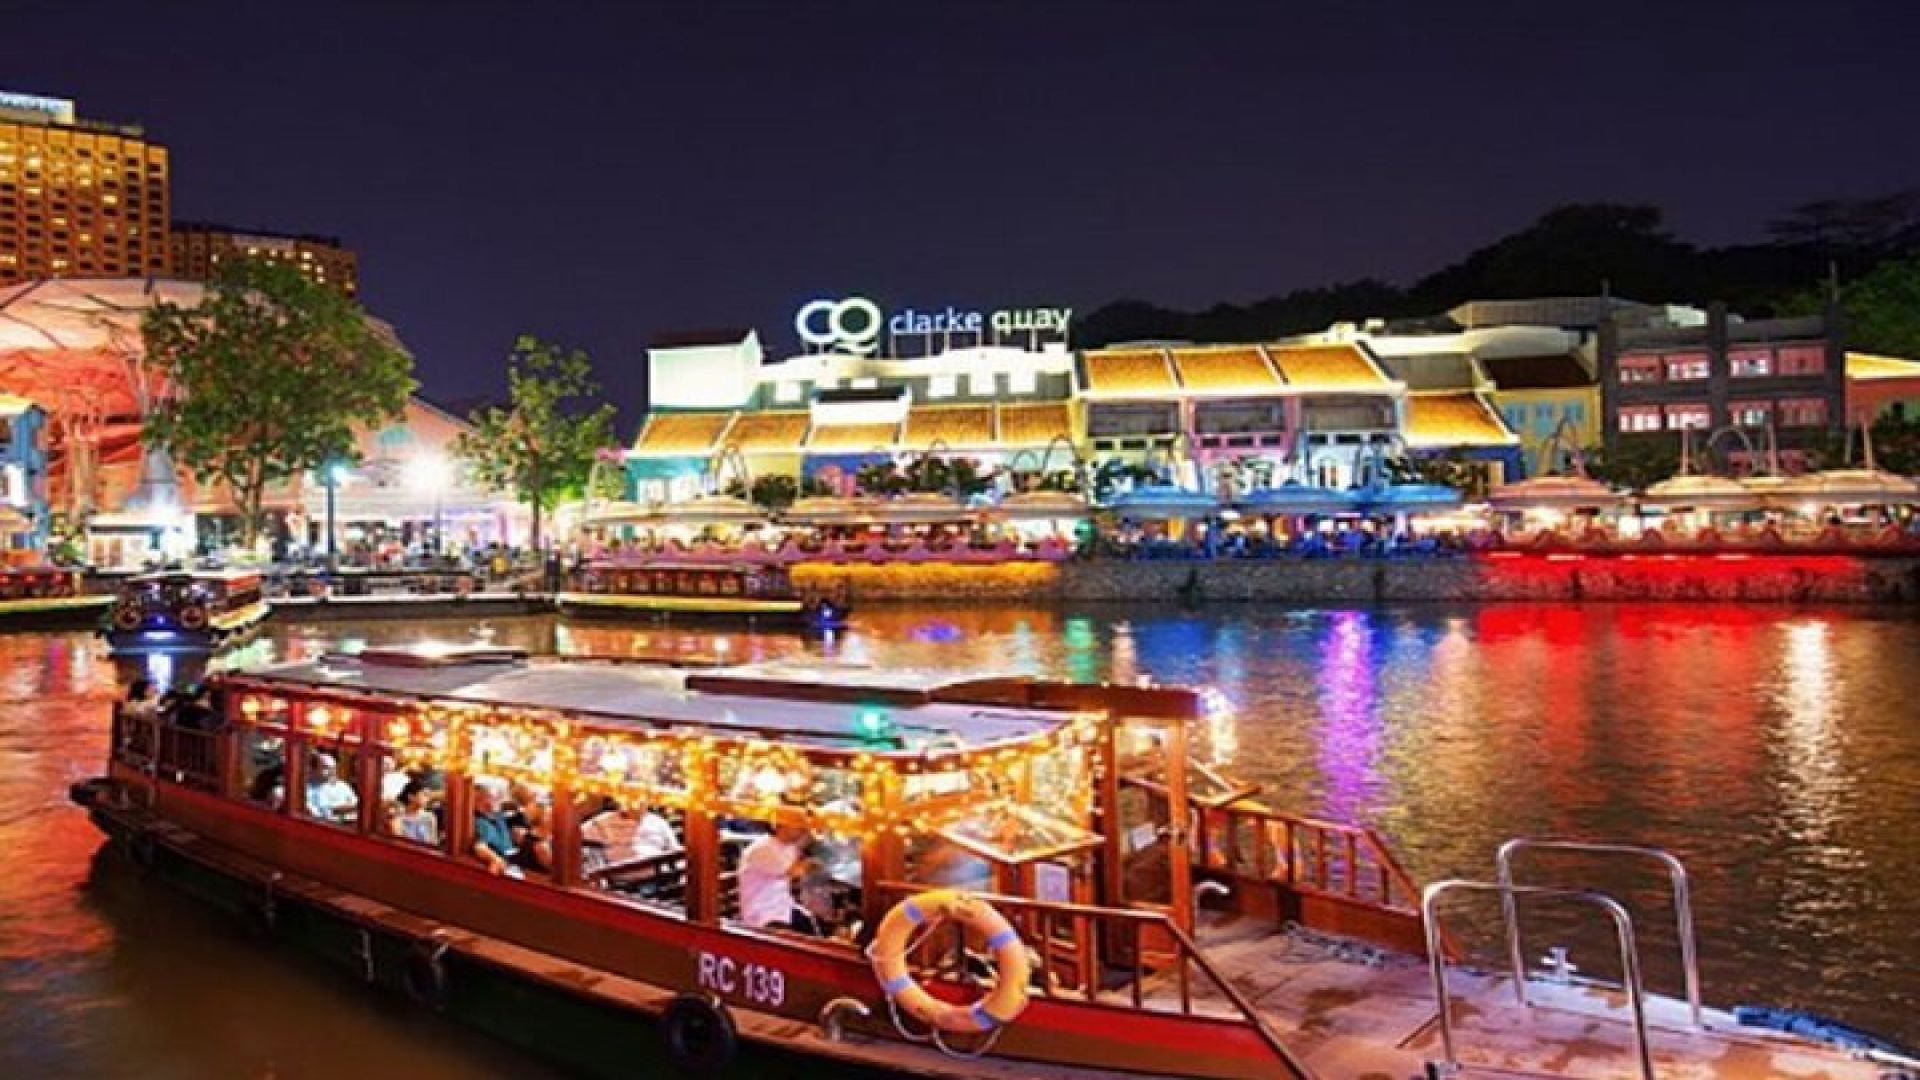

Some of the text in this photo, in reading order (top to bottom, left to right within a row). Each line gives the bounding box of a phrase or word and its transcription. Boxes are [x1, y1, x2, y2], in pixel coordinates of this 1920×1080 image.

[890, 308, 982, 333] clarke
[991, 307, 1072, 335] quay
[700, 952, 785, 1006] RC 139
